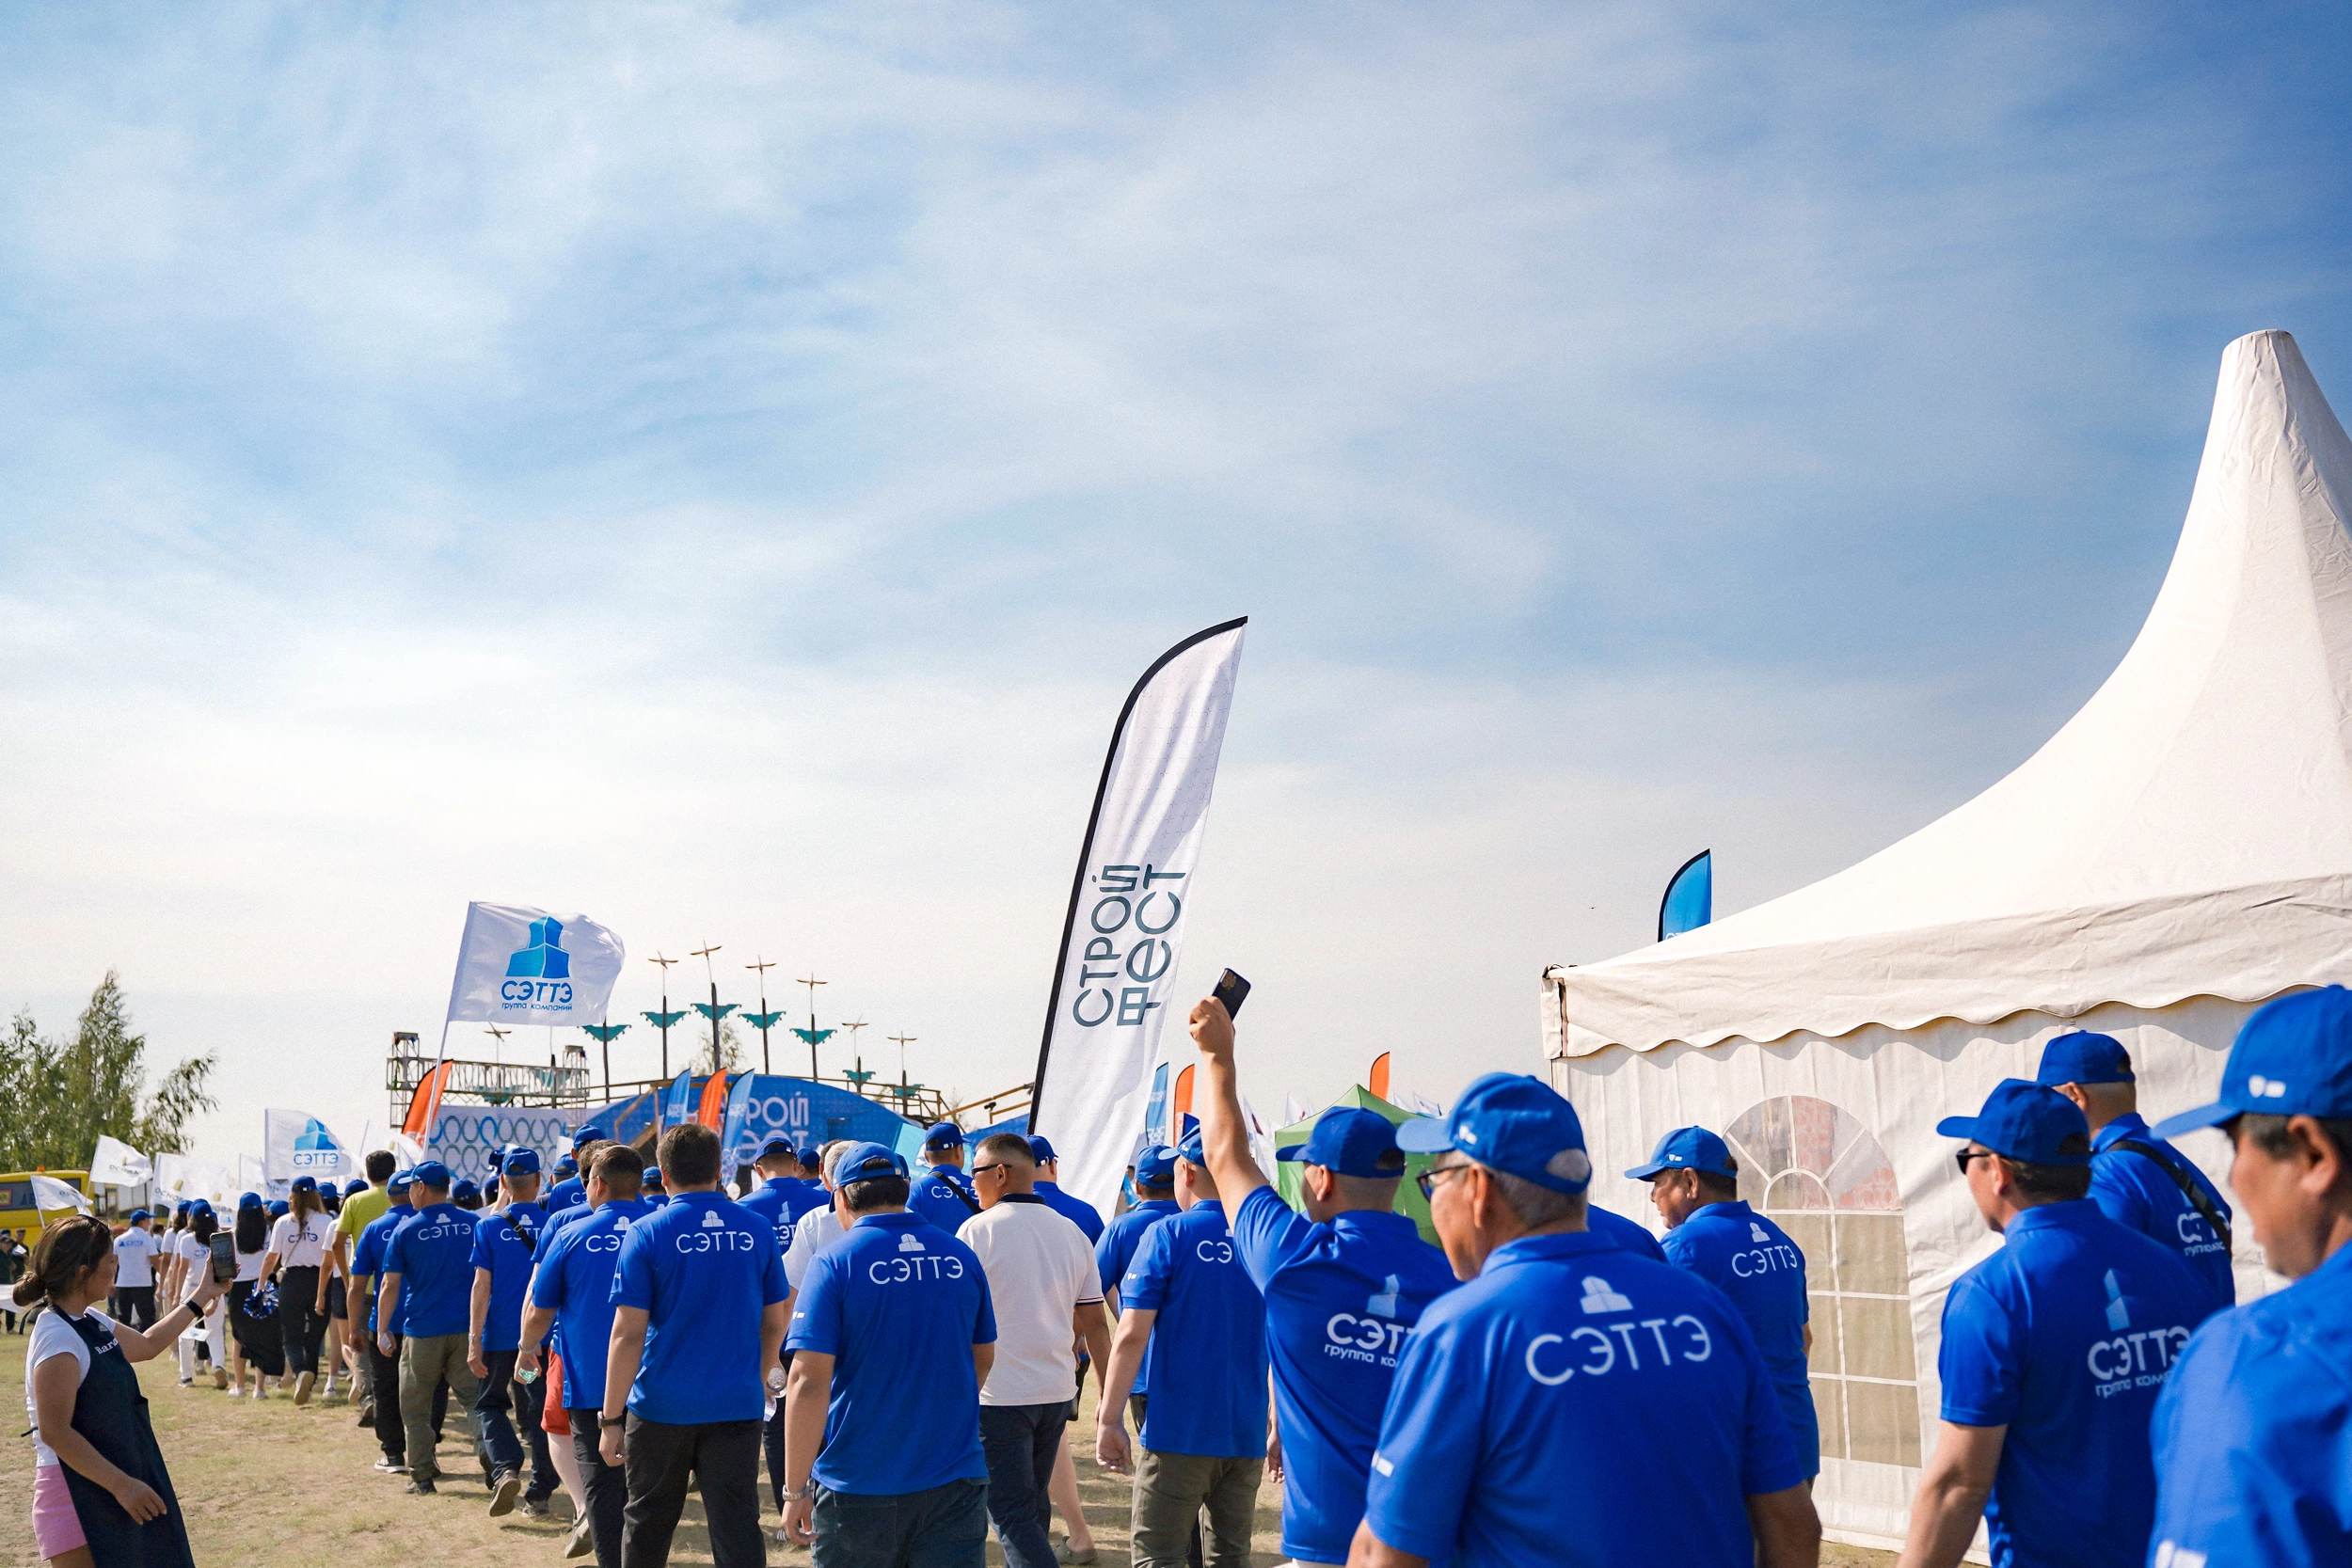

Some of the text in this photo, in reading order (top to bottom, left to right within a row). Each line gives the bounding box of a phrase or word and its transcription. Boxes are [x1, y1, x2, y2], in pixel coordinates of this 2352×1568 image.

[1073, 864, 1140, 1028] СТРОЙ
[501, 980, 573, 1004] СЭТТЭ
[531, 1003, 573, 1011] компаний
[293, 1152, 339, 1165] СЭТТЭ
[418, 1224, 471, 1241] СЭТТЭ
[675, 1231, 755, 1254] СЭТТЭ
[868, 1256, 964, 1285] СЭТТЭ
[1730, 1245, 1798, 1278] СЭТТЭ
[1324, 1343, 1375, 1364] группа
[1525, 1314, 1711, 1386] СЭТТЭ
